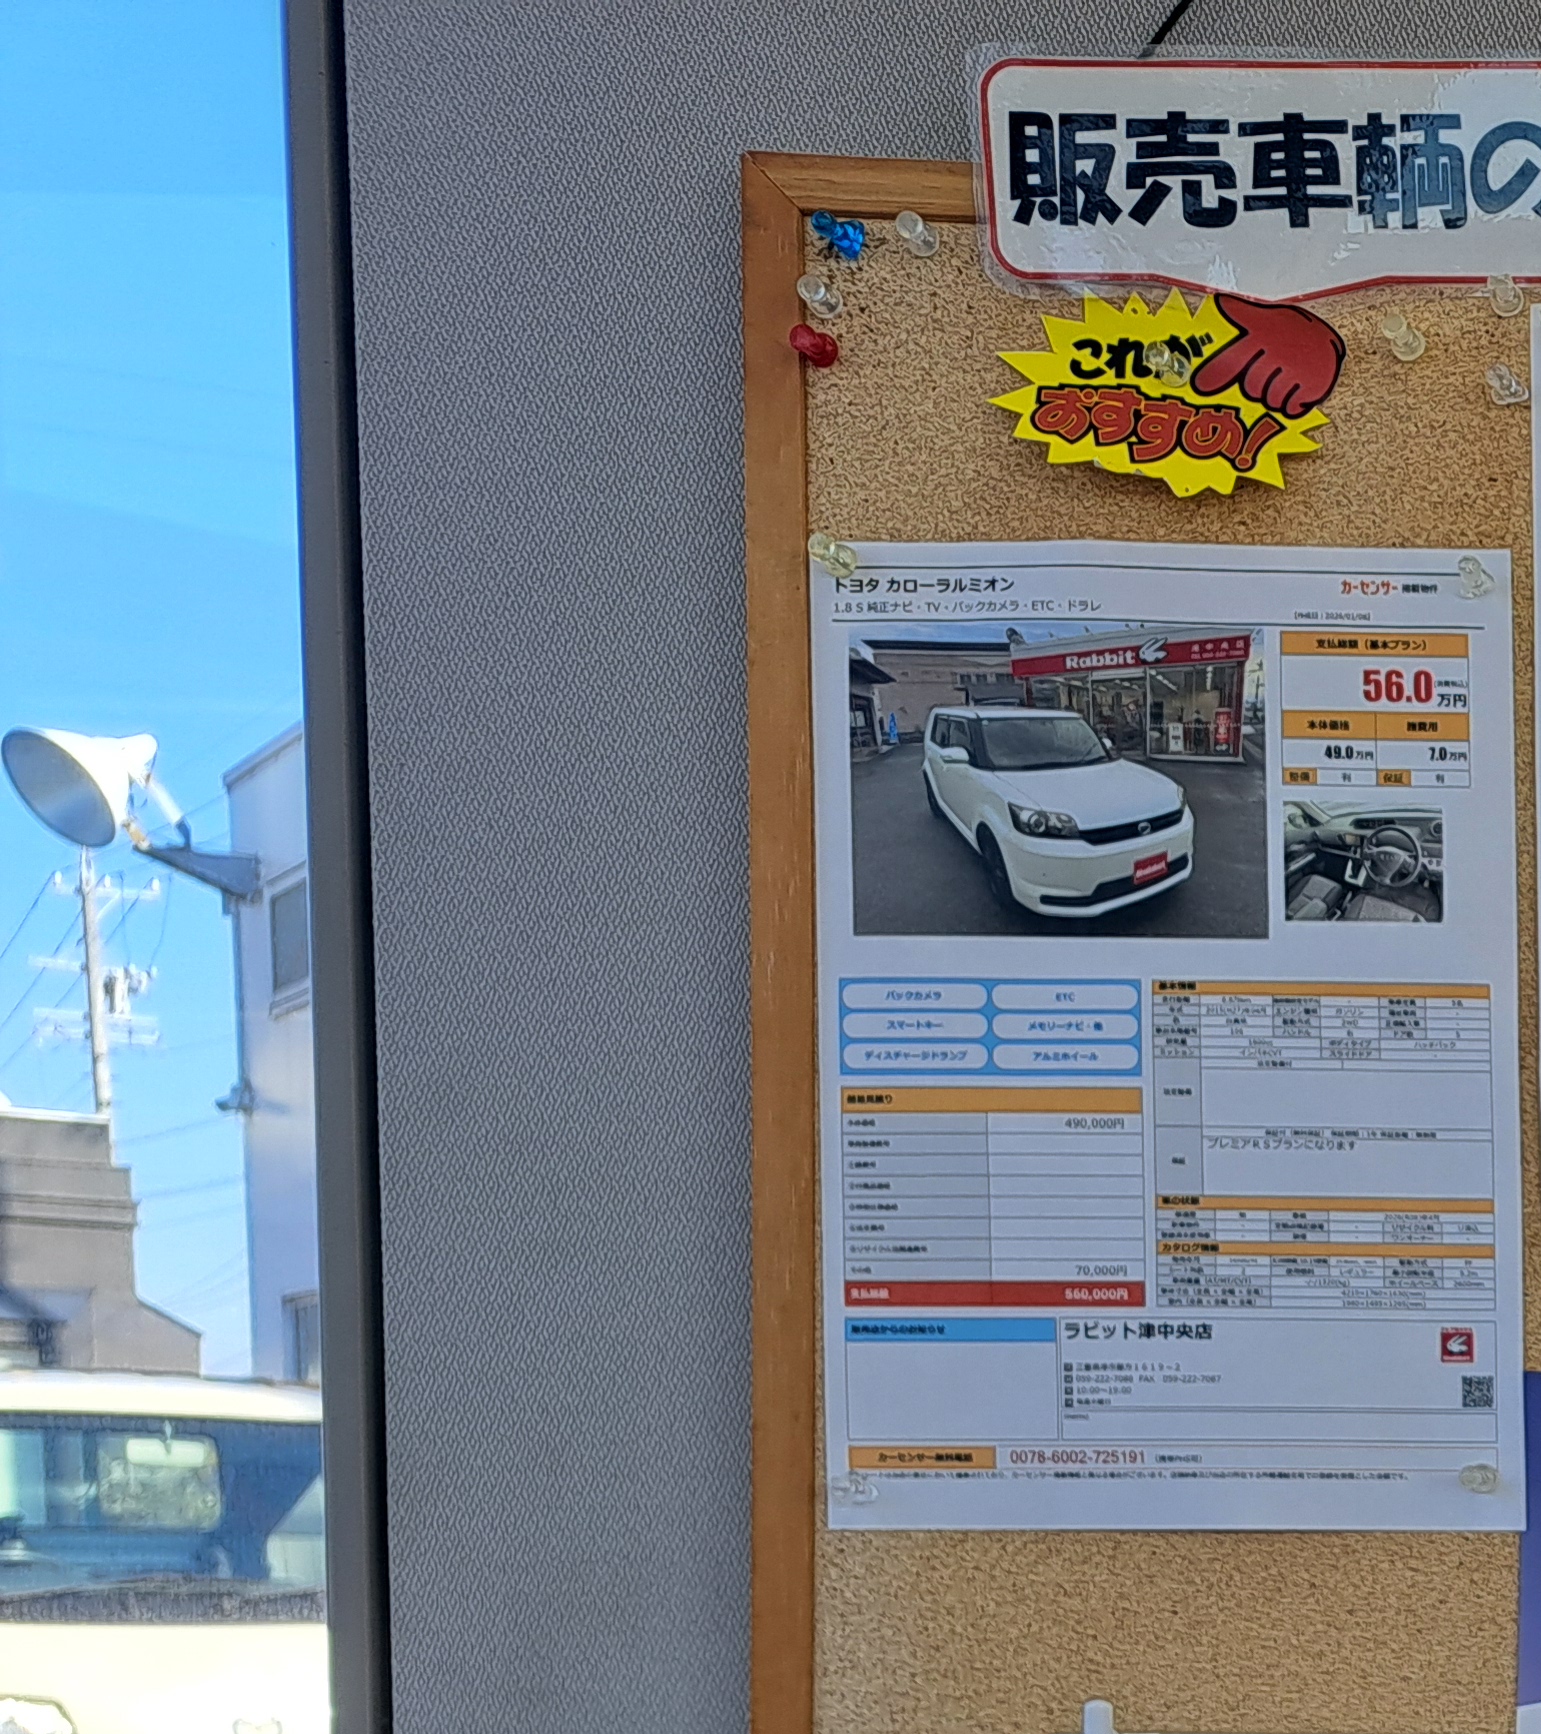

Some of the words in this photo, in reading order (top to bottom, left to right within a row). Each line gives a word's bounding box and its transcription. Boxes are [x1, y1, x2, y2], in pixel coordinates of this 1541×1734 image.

[1032, 386, 1283, 469] おすすめ!
[835, 578, 879, 594] トヨタ
[887, 577, 1015, 593] カローラルミオン
[1341, 580, 1398, 595] カーセンサー
[834, 601, 853, 613] 1.8
[1065, 649, 1135, 670] Rabbit
[1065, 1118, 1125, 1130] 490,000円
[1075, 1265, 1128, 1277] 70,000円
[1064, 1322, 1213, 1341] ラビット津中央店
[1010, 1451, 1145, 1464] 0078-6002-725191
